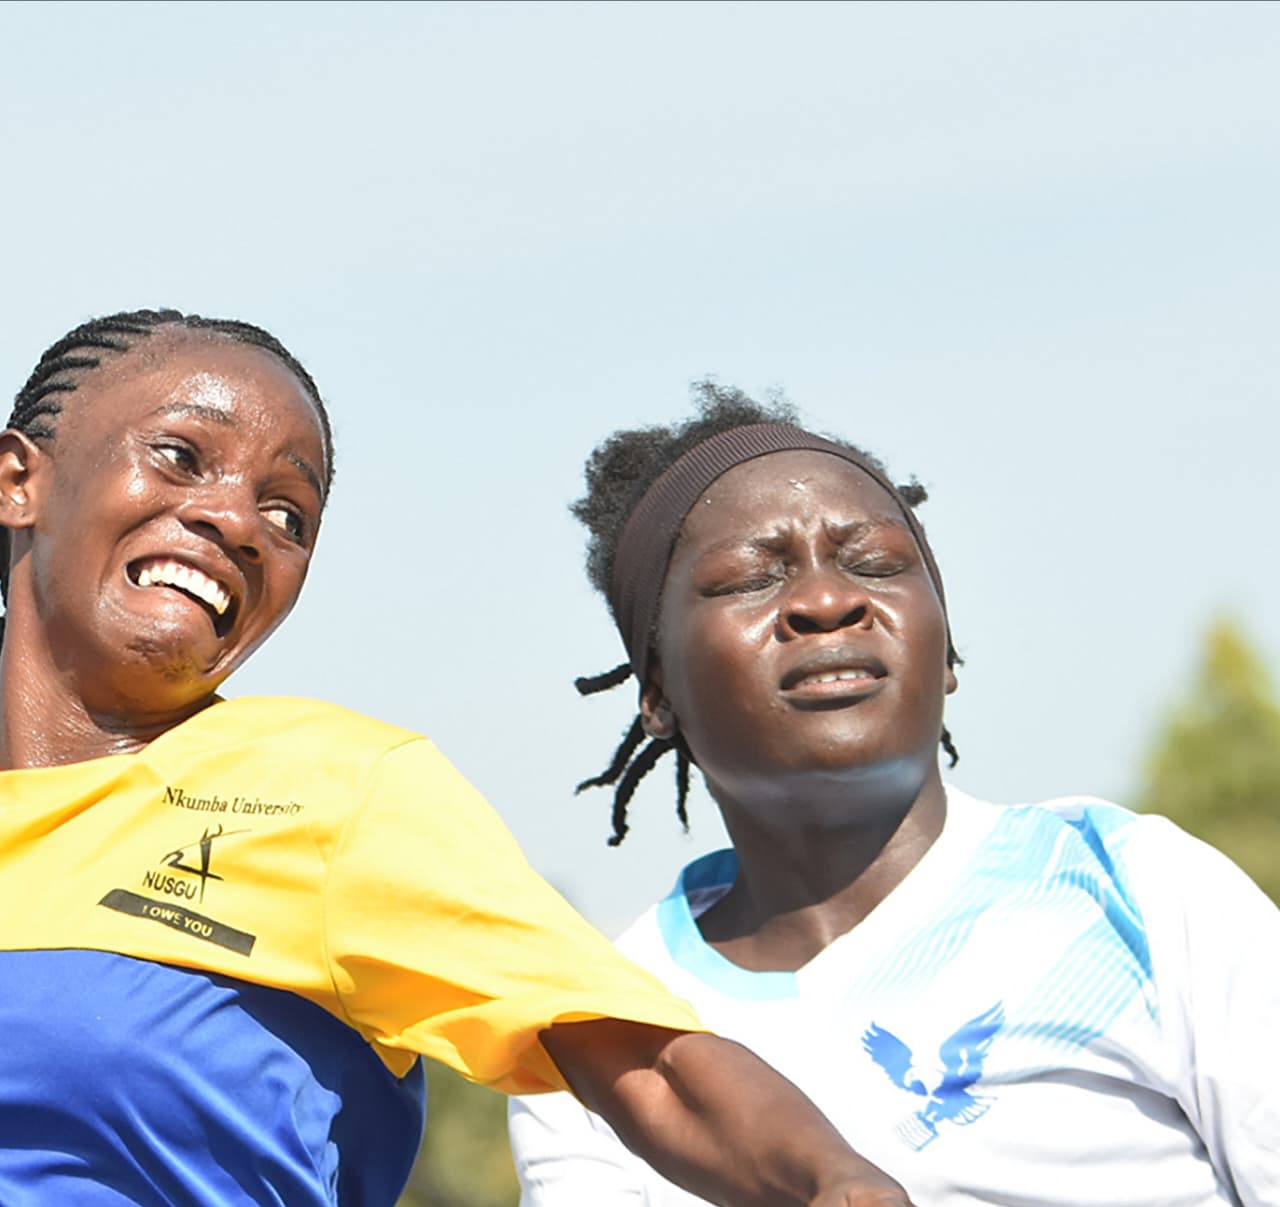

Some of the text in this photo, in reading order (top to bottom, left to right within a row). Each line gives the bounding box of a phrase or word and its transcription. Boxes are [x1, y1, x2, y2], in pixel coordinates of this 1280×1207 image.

[162, 786, 228, 813] Nkumba
[142, 870, 198, 900] NUSGU
[142, 904, 213, 937] I OWE YOU
